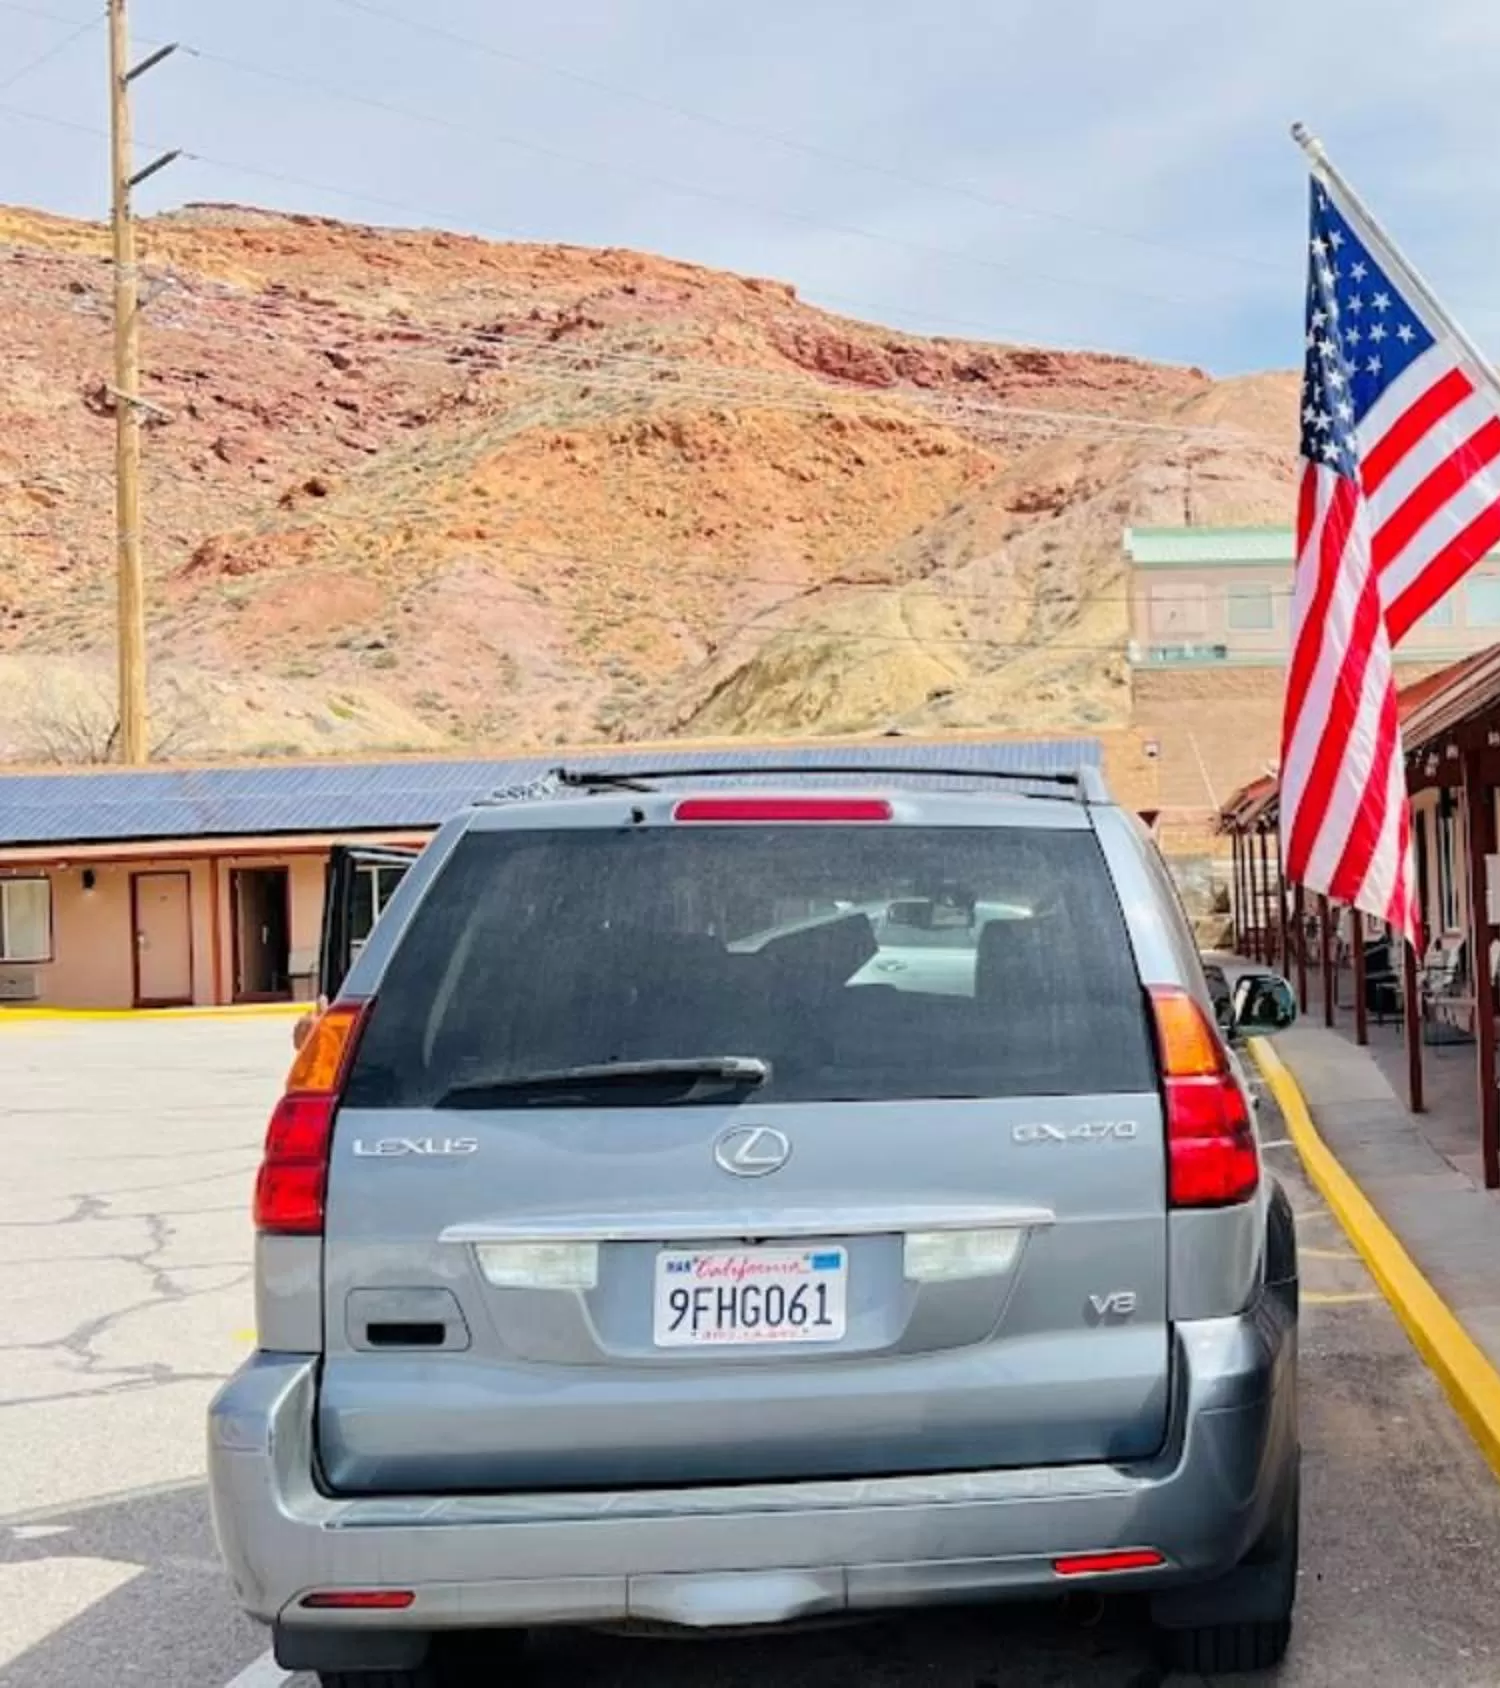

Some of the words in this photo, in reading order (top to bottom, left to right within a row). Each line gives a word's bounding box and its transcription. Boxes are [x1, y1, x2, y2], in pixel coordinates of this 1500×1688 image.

[352, 1137, 478, 1157] LEXUS
[695, 1256, 808, 1281] California
[668, 1282, 833, 1332] 9FHG061
